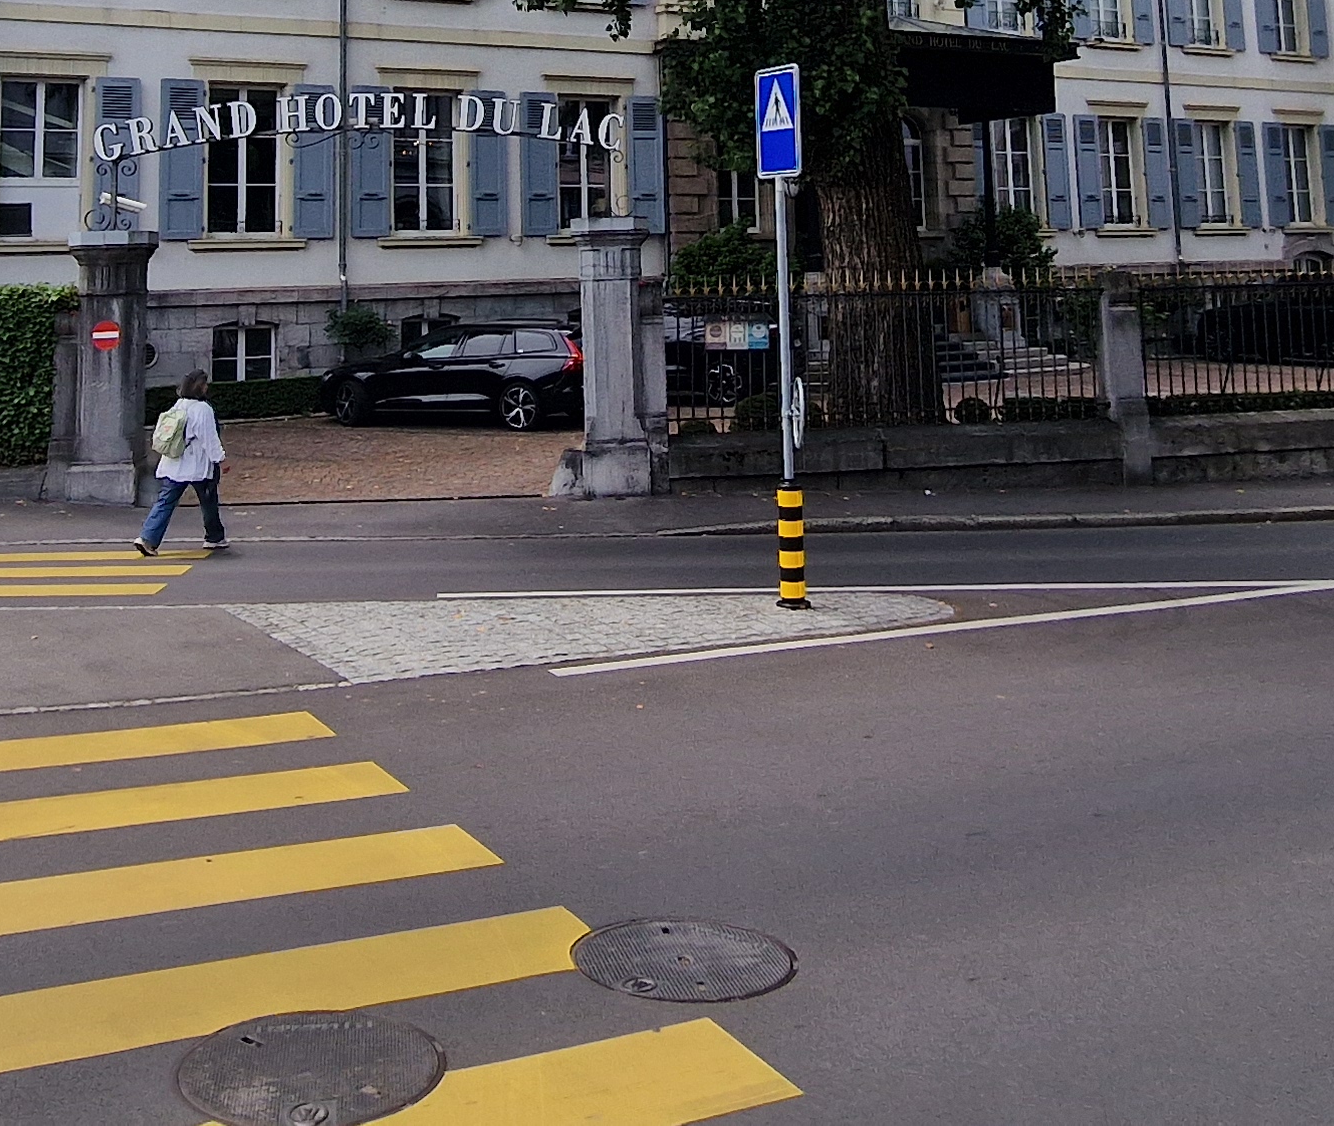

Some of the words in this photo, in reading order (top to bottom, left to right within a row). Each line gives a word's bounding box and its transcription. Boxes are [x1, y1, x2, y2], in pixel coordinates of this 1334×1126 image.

[93, 100, 258, 162] GRAND
[276, 92, 437, 134] HOTEL
[455, 94, 521, 136] DU
[536, 102, 625, 151] LAC
